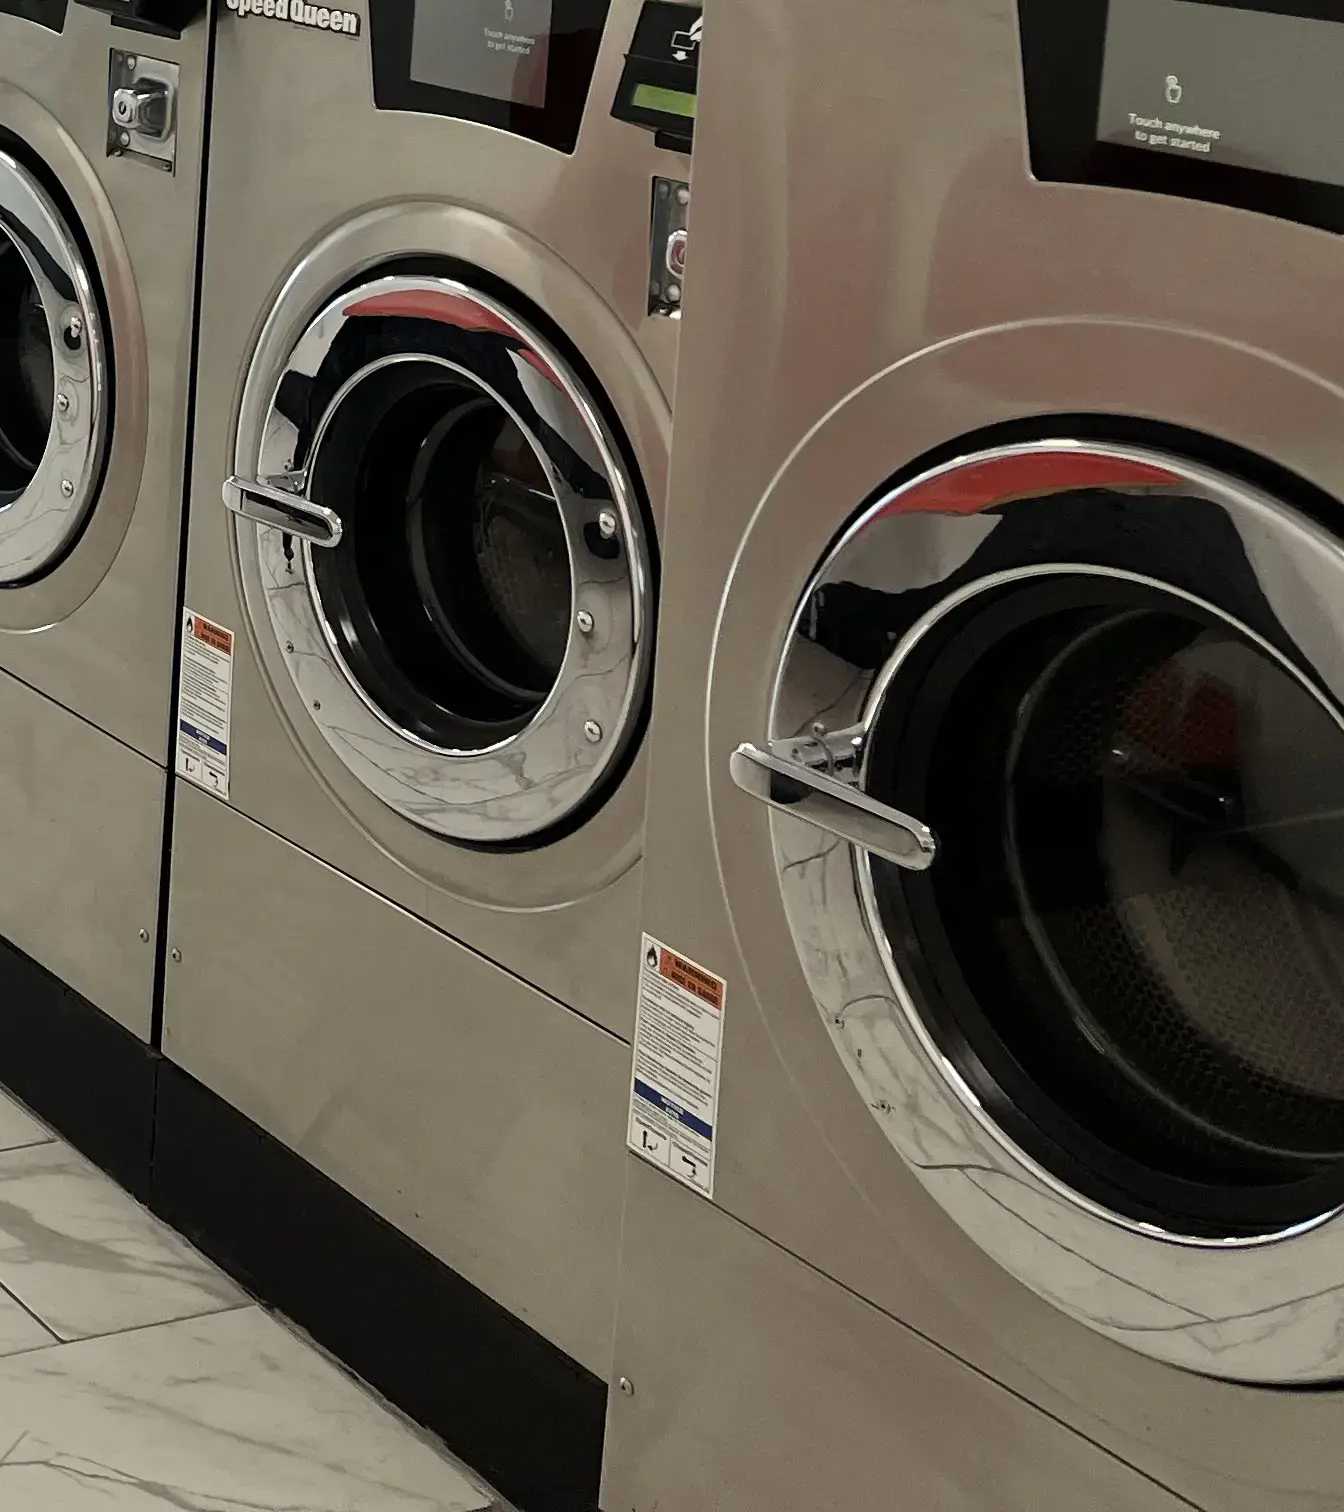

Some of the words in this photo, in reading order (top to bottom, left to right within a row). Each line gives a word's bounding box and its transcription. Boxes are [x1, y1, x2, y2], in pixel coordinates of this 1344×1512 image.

[1128, 112, 1163, 129] Touch
[1164, 122, 1221, 140] anywhere
[1135, 131, 1148, 142] to
[1148, 134, 1168, 145] get
[1169, 138, 1211, 153] started
